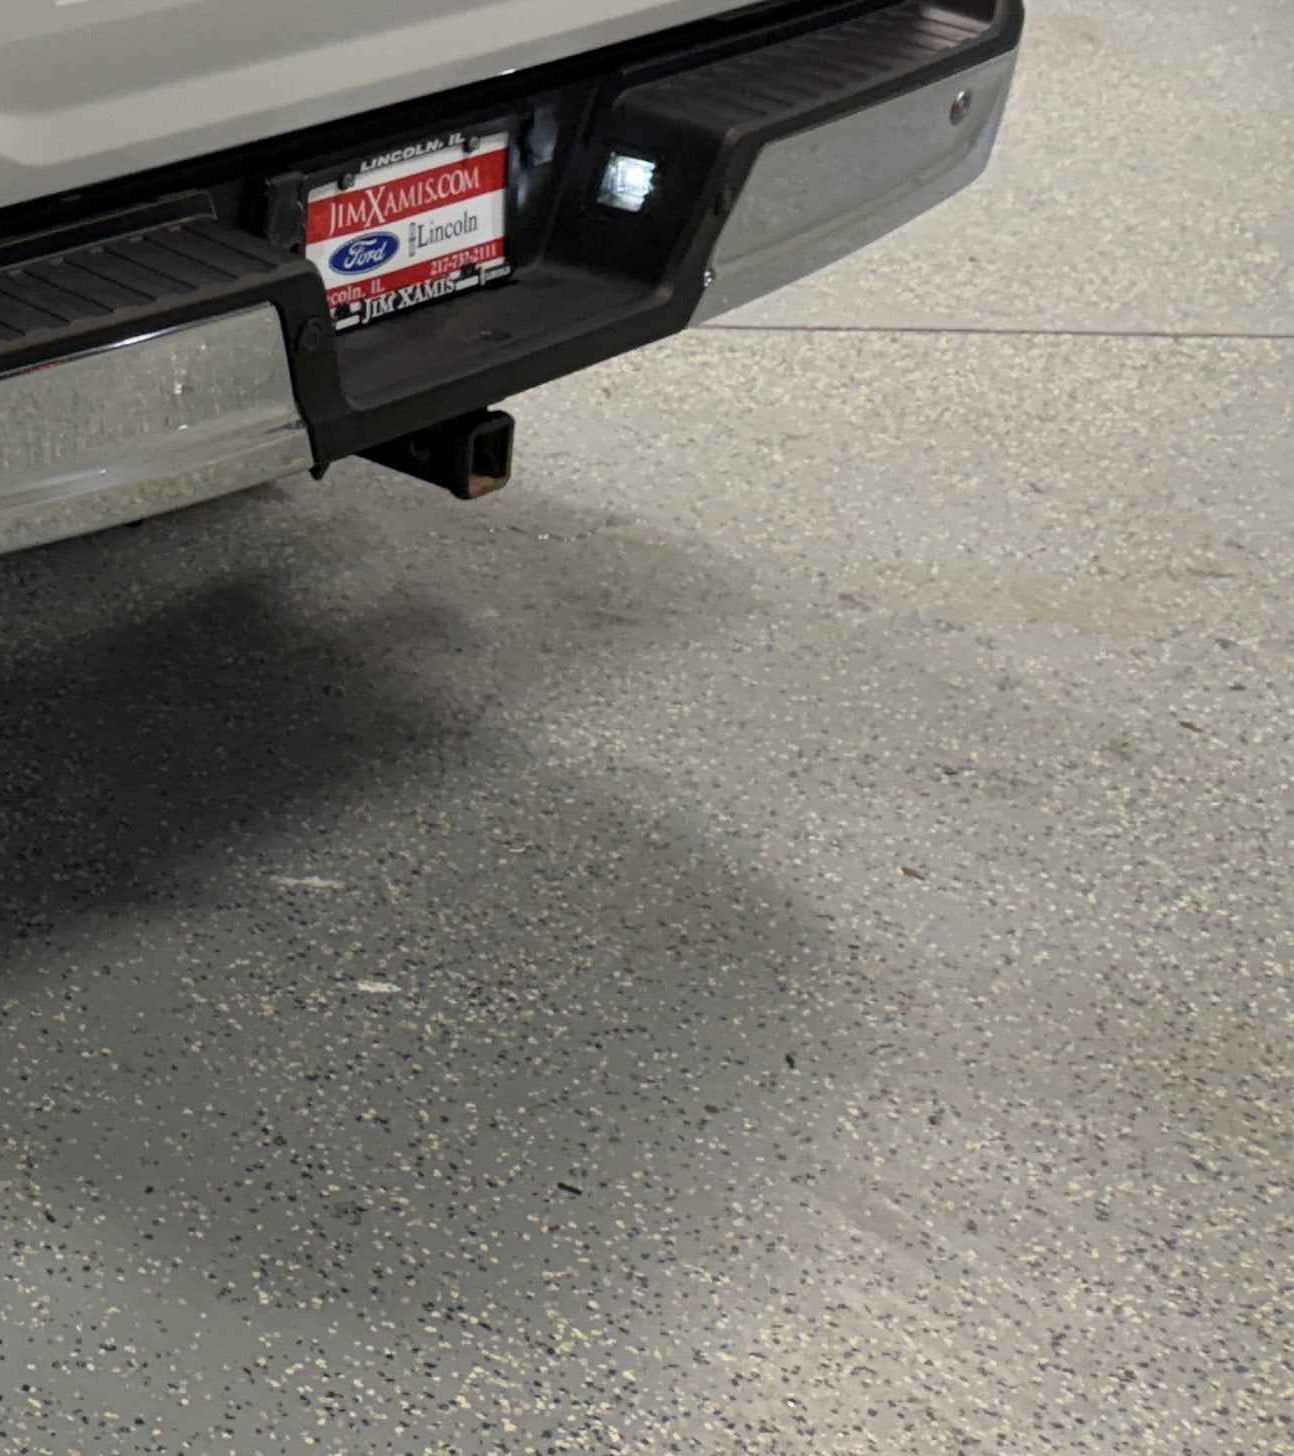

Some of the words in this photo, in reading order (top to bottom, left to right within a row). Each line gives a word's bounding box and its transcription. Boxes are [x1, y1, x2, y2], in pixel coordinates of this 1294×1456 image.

[448, 132, 466, 146] IL
[329, 166, 480, 237] JIMXAMIS.COM
[417, 211, 478, 248] Lincoln
[344, 237, 387, 269] Ford
[362, 292, 395, 325] JIM
[397, 275, 457, 311] XAMIS
